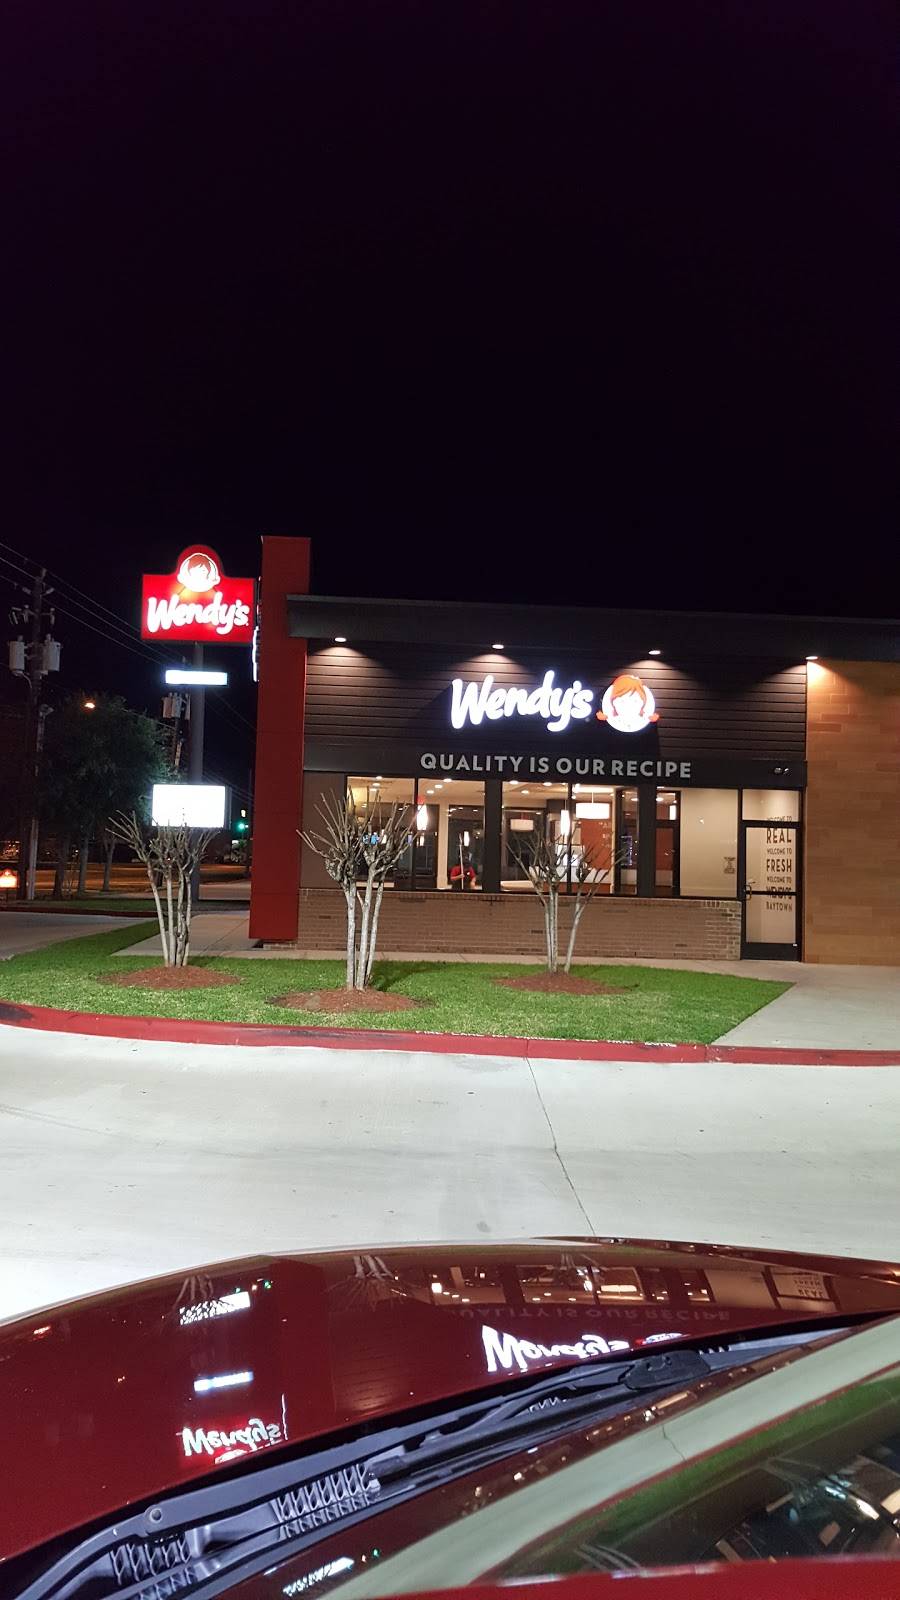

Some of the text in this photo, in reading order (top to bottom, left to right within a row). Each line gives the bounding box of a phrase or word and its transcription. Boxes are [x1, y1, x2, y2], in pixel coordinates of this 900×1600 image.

[147, 591, 250, 634] Wendy's
[451, 670, 593, 732] Wendy's
[420, 752, 691, 778] QUALITY IS OUR RECIPE
[766, 828, 792, 843] REAL
[766, 859, 792, 873] FRESH
[786, 876, 792, 884] TO
[766, 901, 793, 912] BAYTOWN
